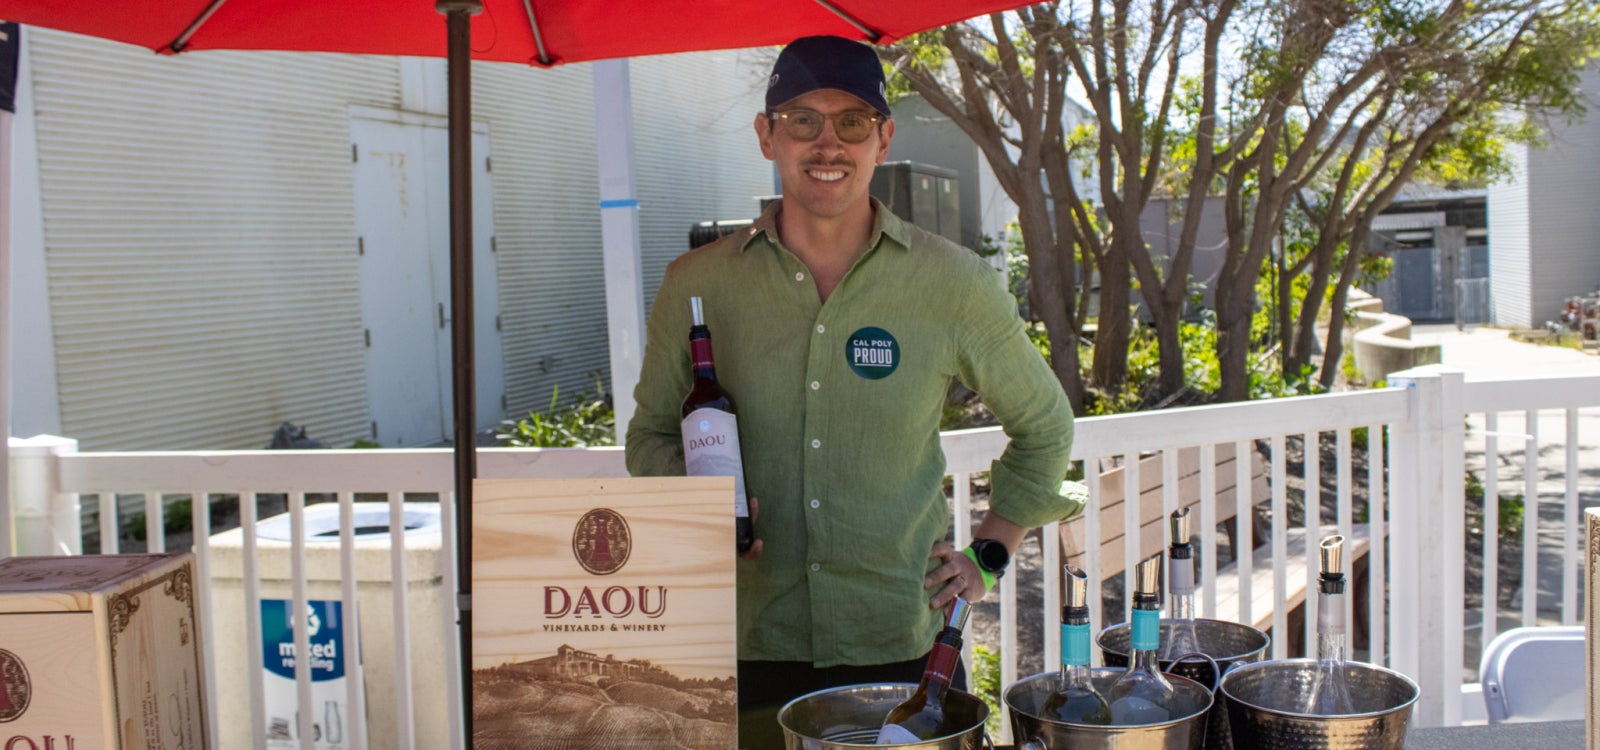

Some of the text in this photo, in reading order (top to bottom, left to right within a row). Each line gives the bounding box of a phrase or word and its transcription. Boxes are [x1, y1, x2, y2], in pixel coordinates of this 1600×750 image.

[854, 347, 892, 365] PROUD
[689, 434, 726, 450] DAOU
[543, 585, 667, 619] DAOU
[543, 623, 666, 632] VINEYARDS & WINERY
[279, 638, 336, 658] med
